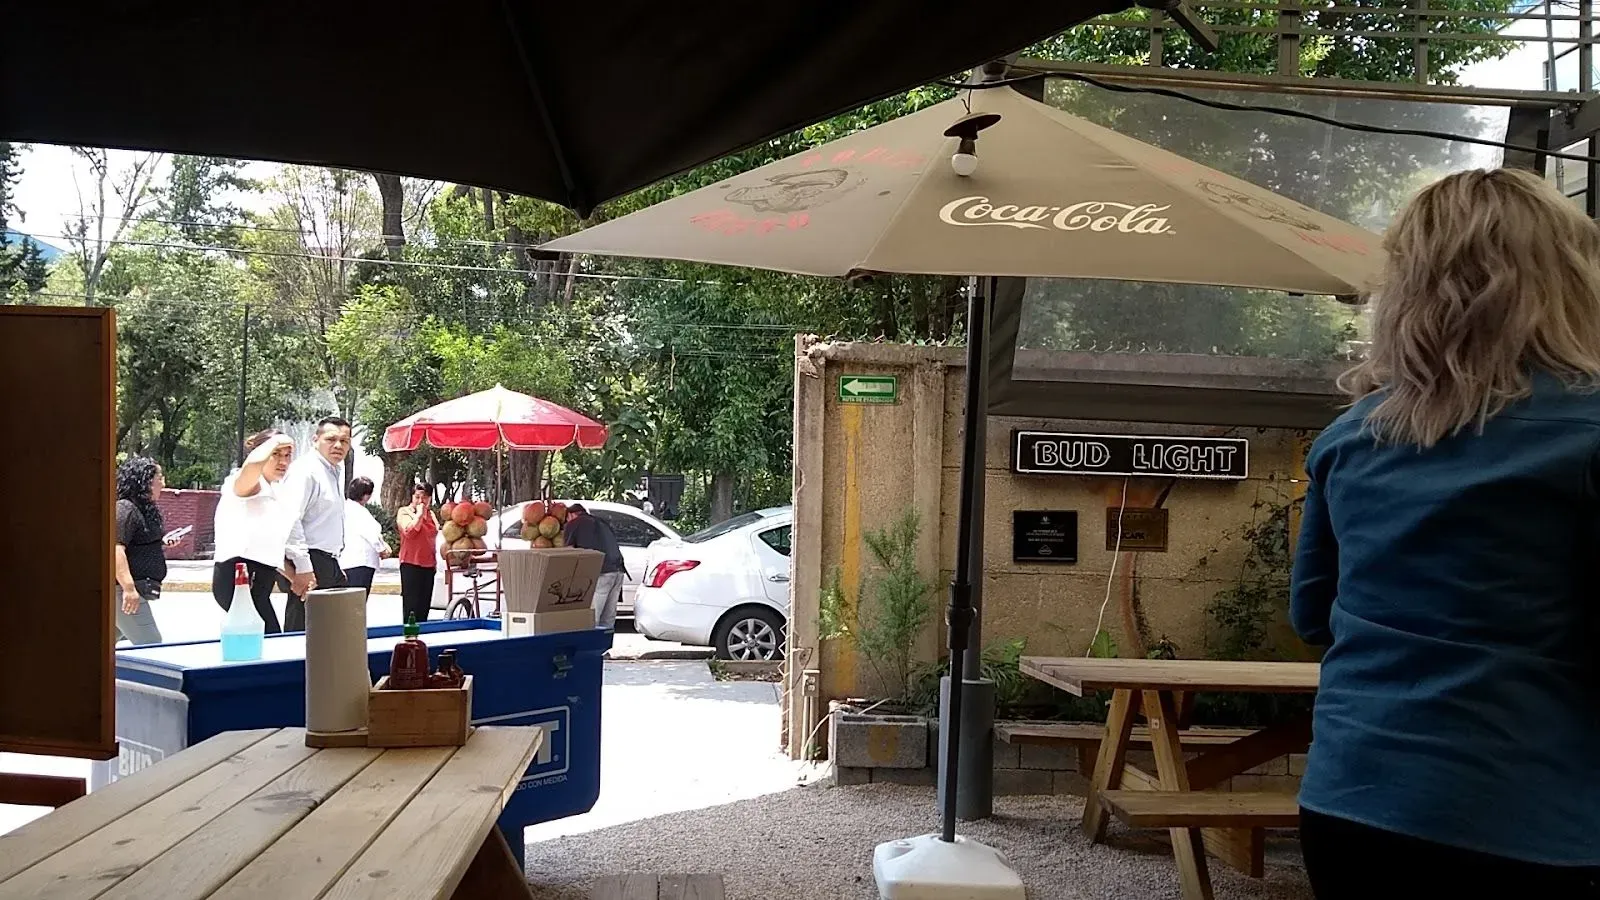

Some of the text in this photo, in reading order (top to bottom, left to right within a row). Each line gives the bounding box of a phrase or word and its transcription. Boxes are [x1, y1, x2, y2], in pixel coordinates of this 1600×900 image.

[939, 196, 1172, 234] Coca-Cola
[1034, 441, 1237, 471] BUD LIGHT
